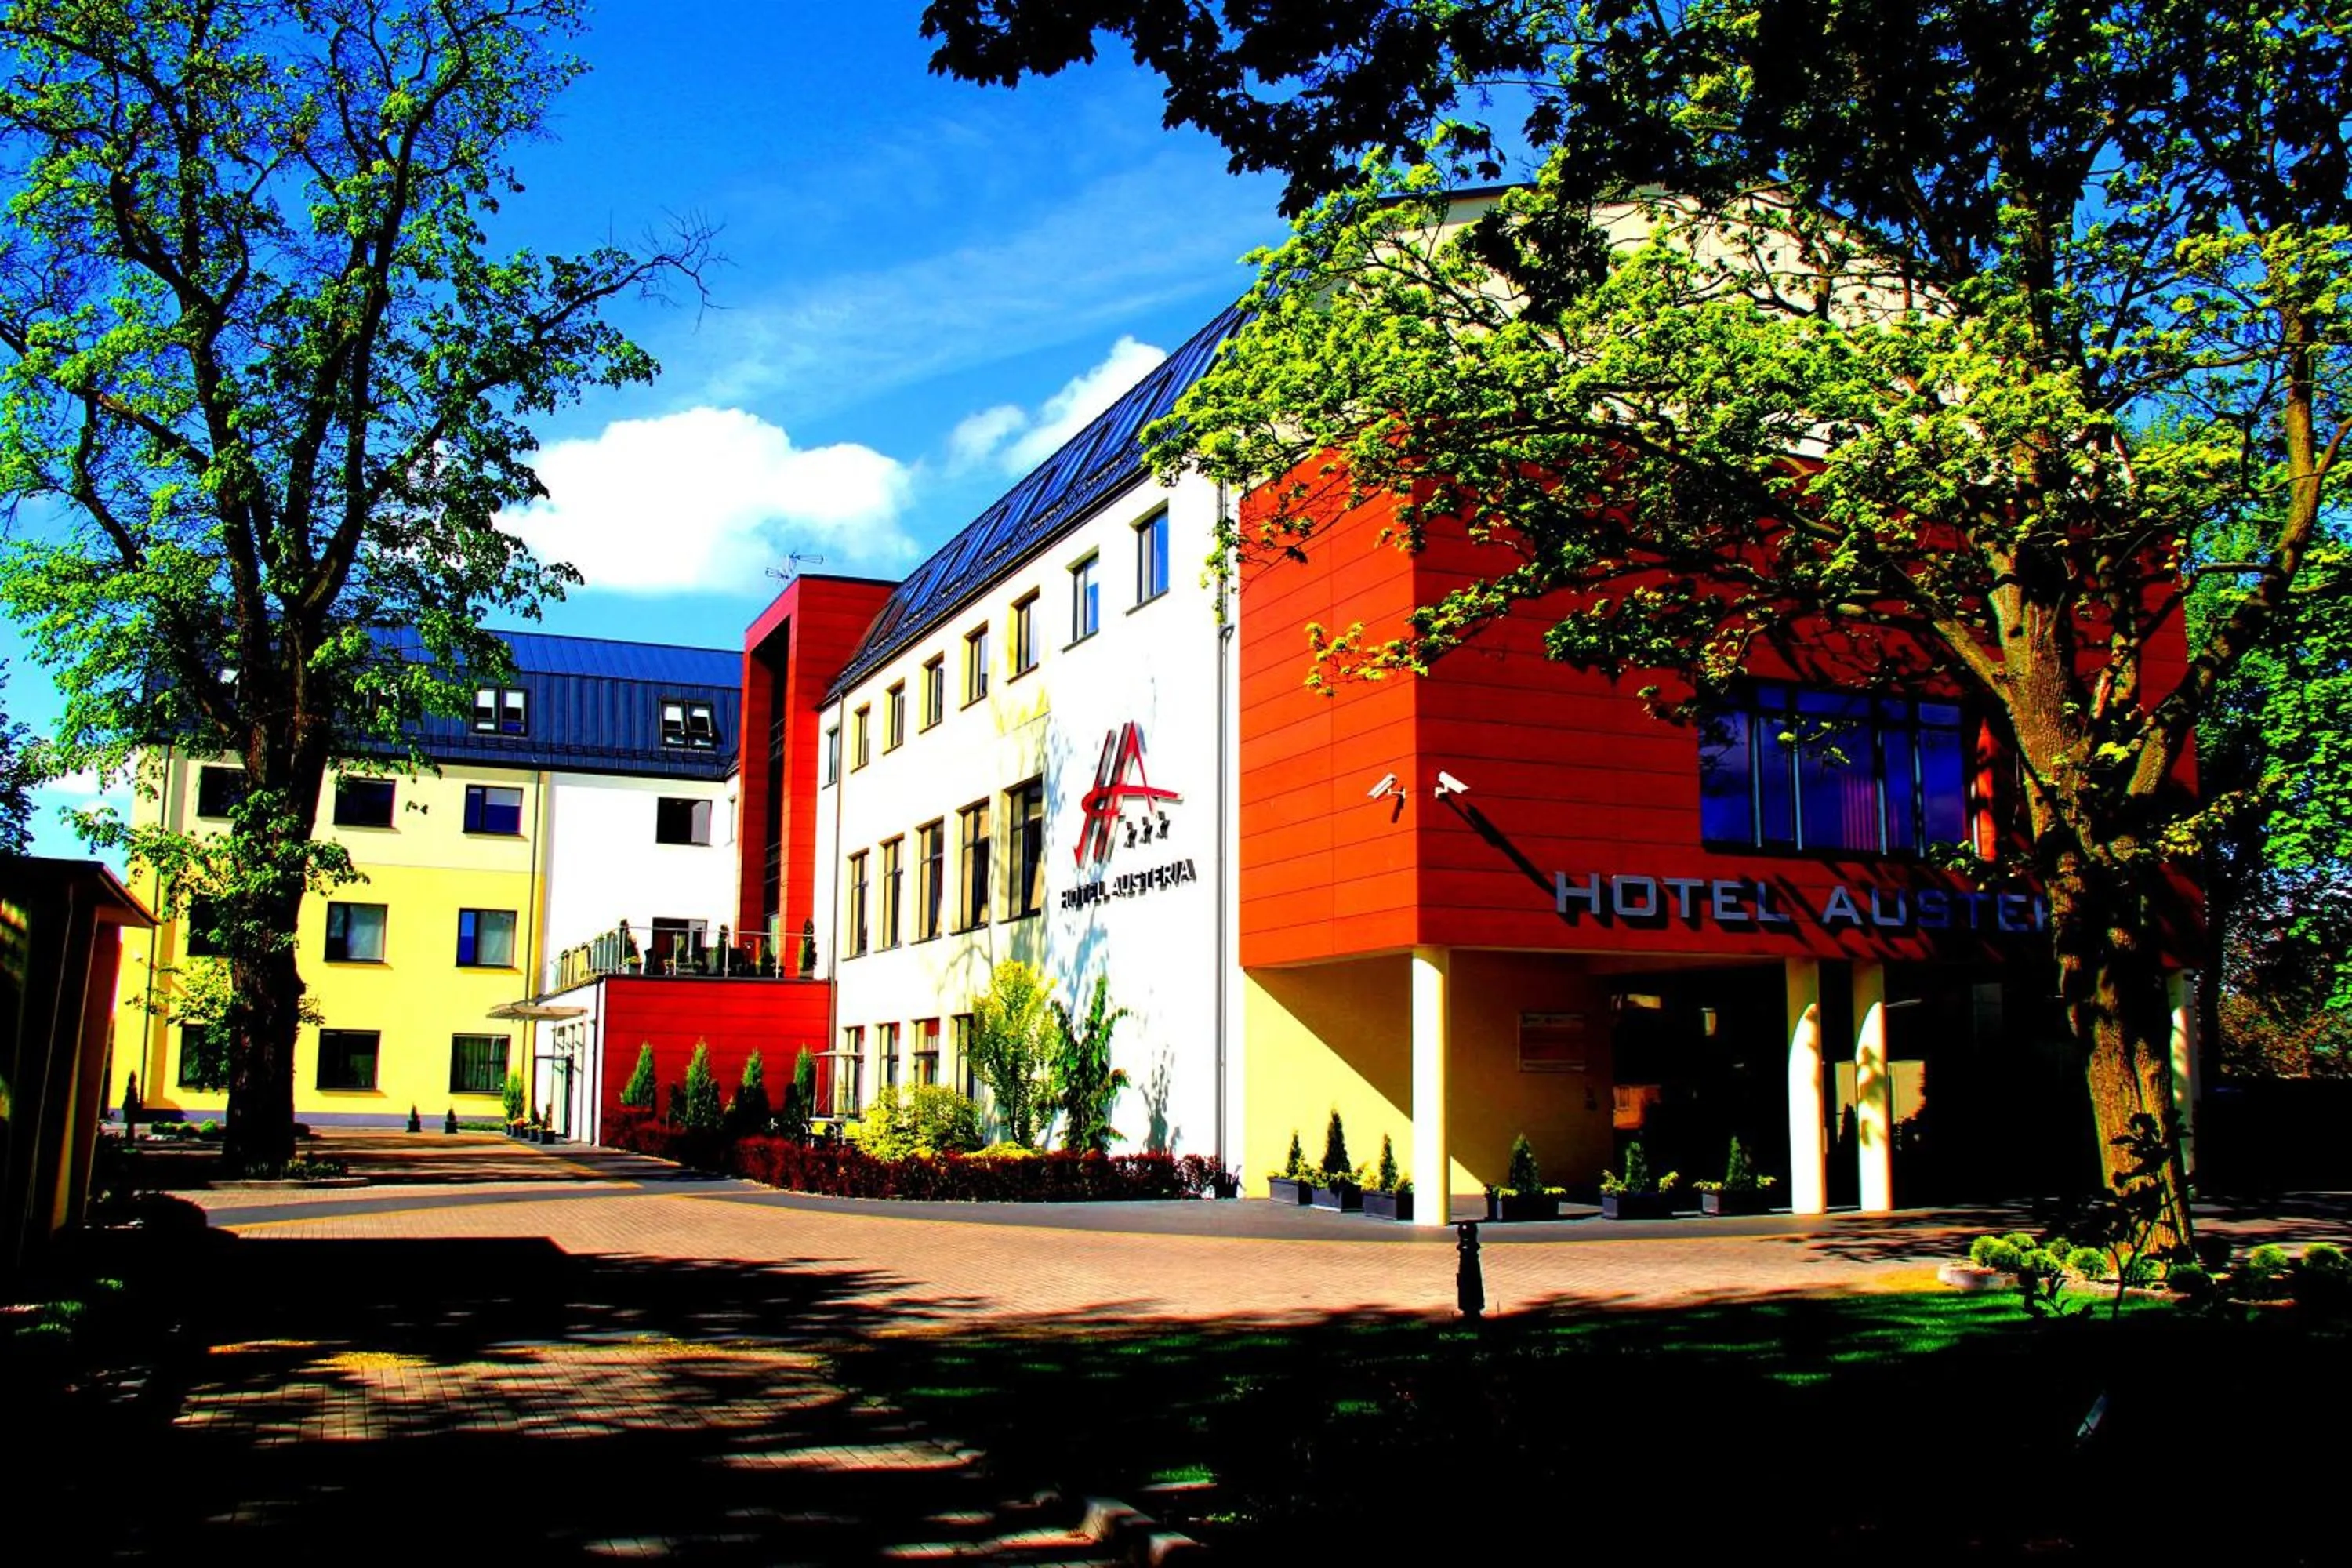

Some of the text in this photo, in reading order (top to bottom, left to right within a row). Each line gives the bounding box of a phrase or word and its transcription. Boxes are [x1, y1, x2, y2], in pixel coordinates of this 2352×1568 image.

[1061, 858, 1197, 909] HOTEL AUSTERIA
[1555, 870, 1789, 923] HOTEL
